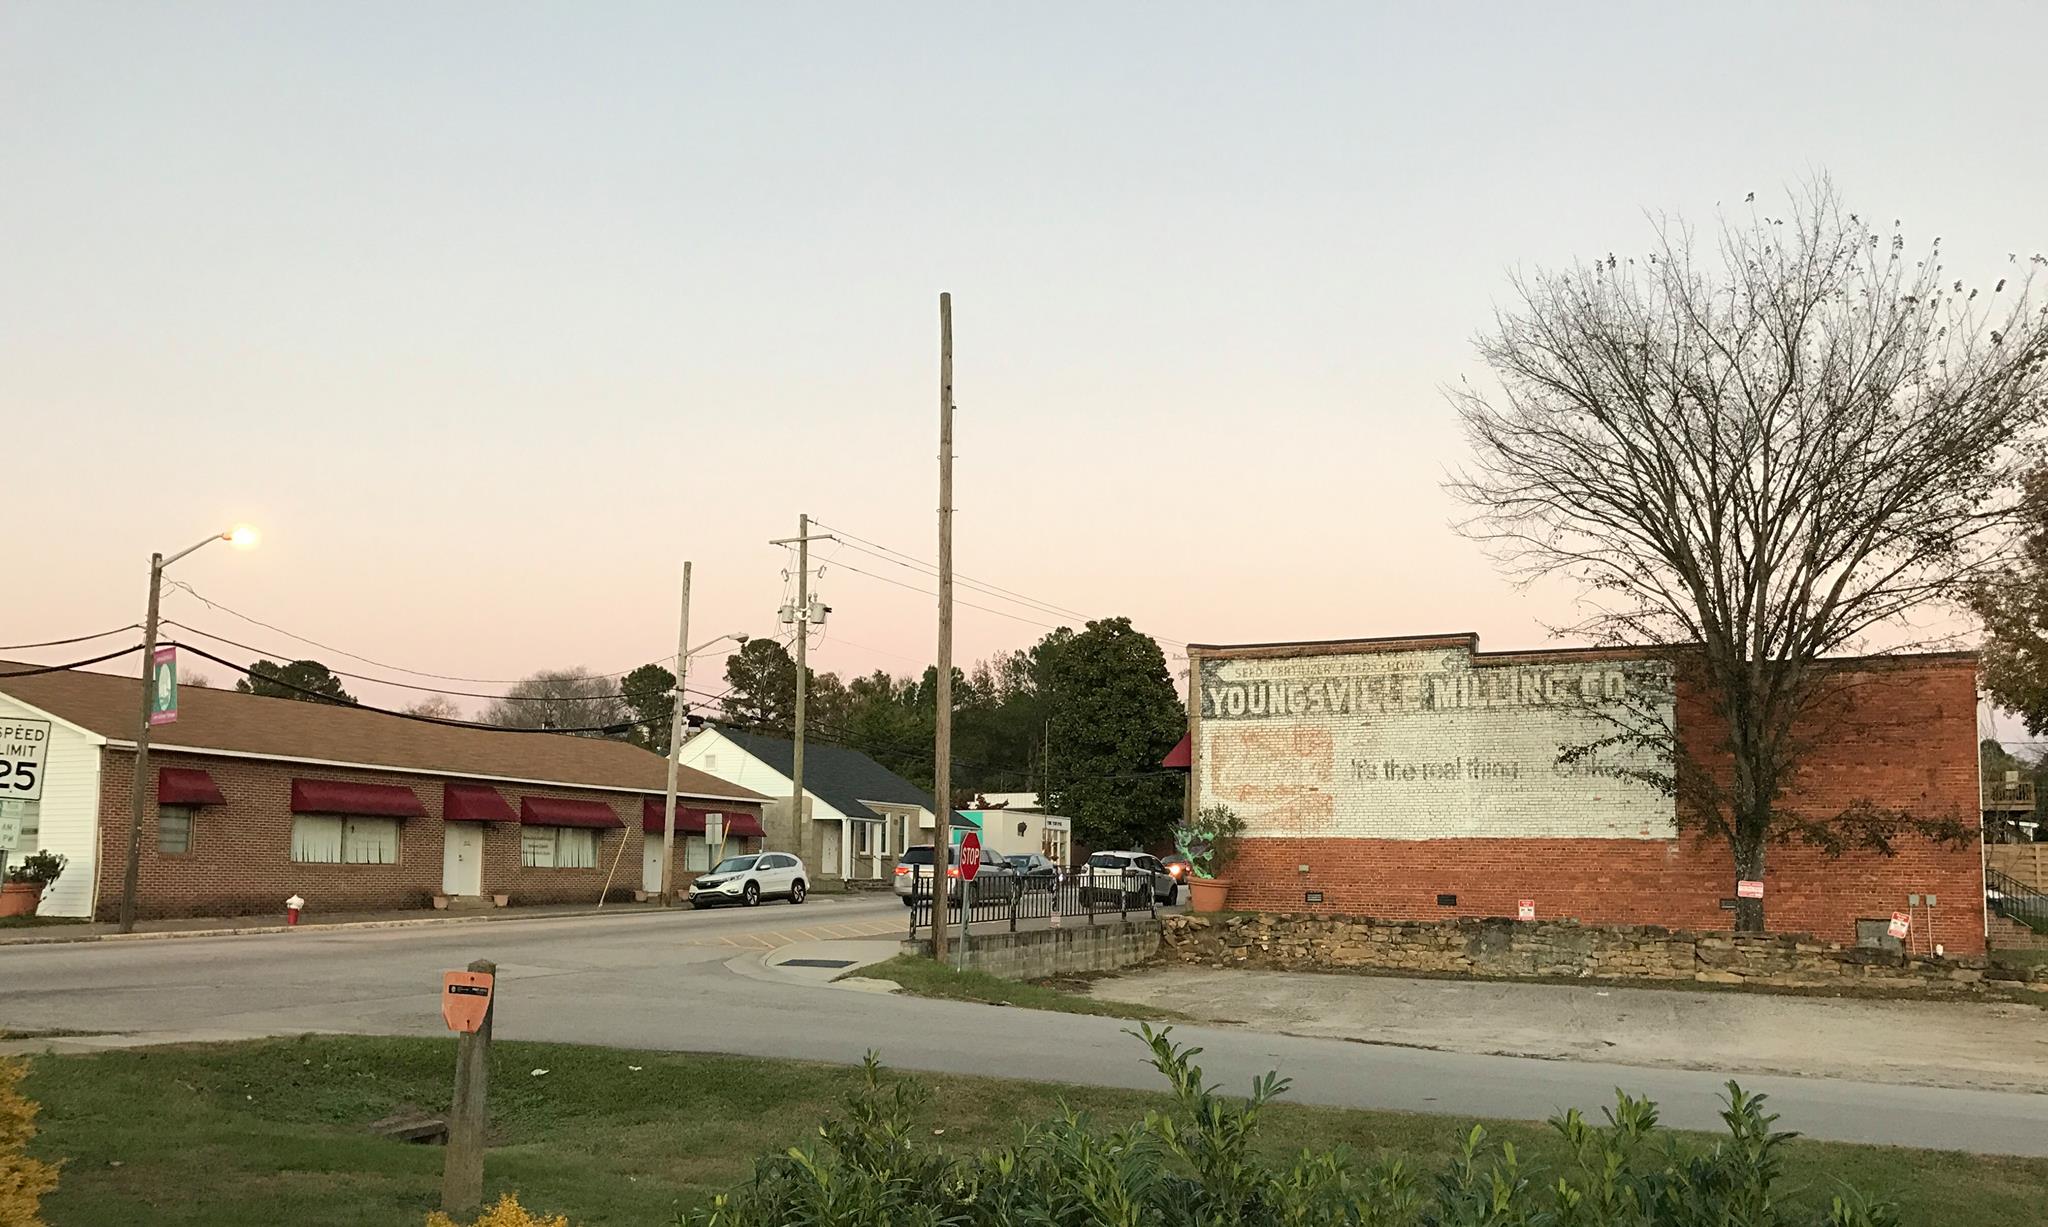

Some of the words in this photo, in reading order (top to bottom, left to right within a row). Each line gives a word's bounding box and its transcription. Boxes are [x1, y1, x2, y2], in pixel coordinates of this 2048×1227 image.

[1209, 680, 1421, 716] YOUNGSVILLE
[1433, 671, 1568, 710] MILLING
[0, 727, 44, 741] PEED
[1384, 757, 1418, 781] the
[1423, 756, 1461, 781] real
[962, 847, 979, 865] STOP
